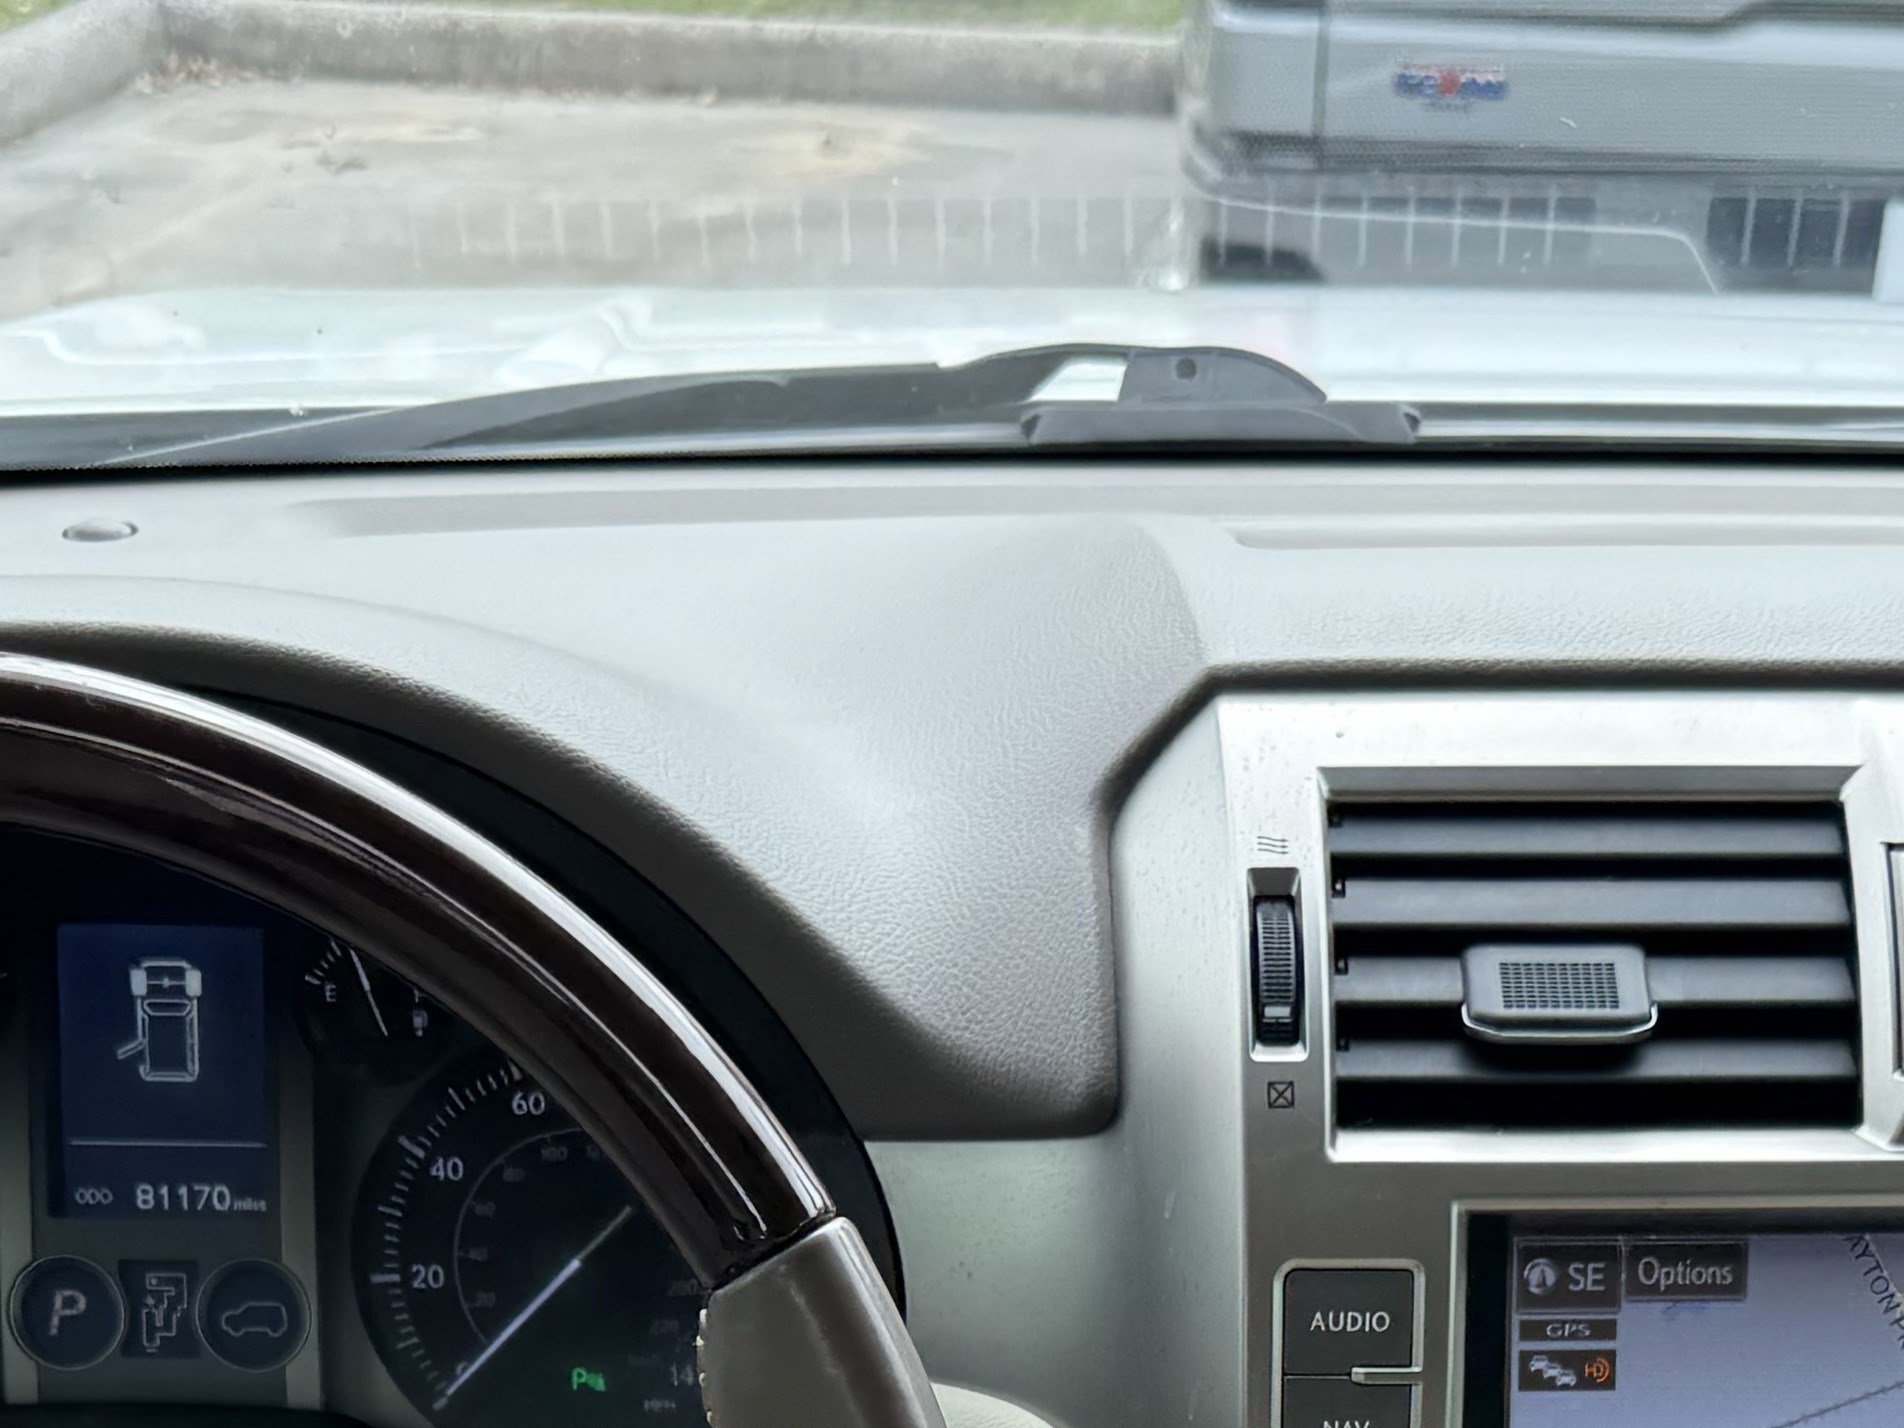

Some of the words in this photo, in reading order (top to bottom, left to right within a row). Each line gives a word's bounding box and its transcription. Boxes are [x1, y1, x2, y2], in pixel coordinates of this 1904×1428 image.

[511, 1090, 546, 1115] 60
[428, 1157, 464, 1182] 40
[135, 1185, 232, 1212] 81170
[411, 1264, 445, 1290] 20
[1567, 1262, 1606, 1292] SE
[1637, 1255, 1733, 1292] Options
[1309, 1310, 1391, 1333] AUDIO
[1546, 1323, 1591, 1338] GPS
